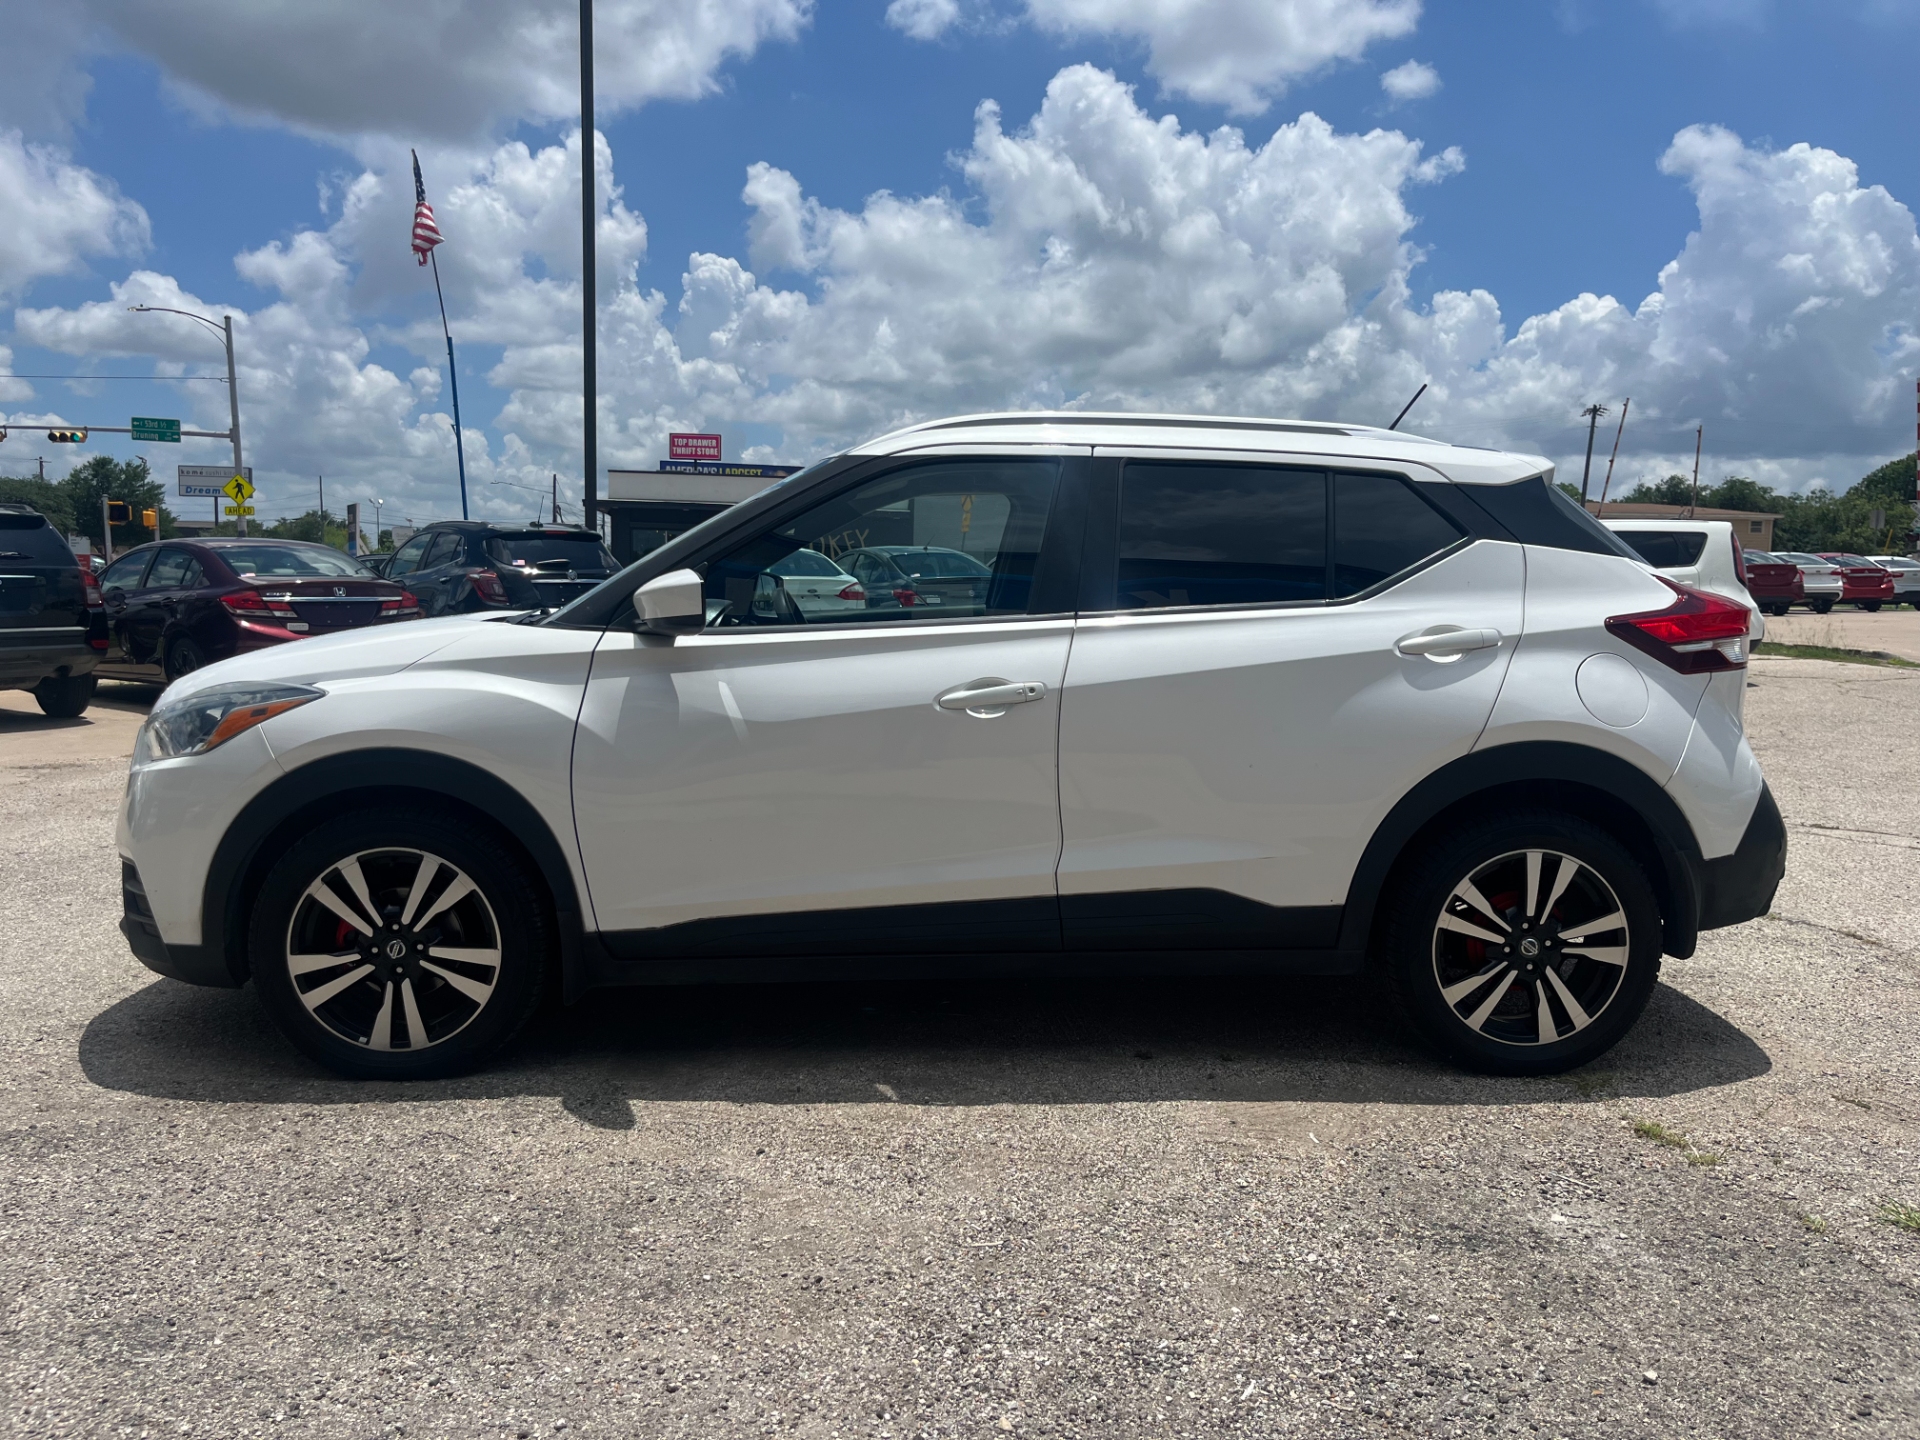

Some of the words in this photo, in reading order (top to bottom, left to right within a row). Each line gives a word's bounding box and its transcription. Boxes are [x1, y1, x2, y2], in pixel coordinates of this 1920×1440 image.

[144, 420, 158, 428] 53rd
[133, 431, 158, 440] Bruning
[674, 438, 687, 446] TOP
[688, 438, 716, 447] DRAWER
[673, 447, 696, 455] THRIFT
[697, 447, 718, 455] STORE
[185, 486, 220, 495] Dream
[228, 507, 252, 515] AHEAD
